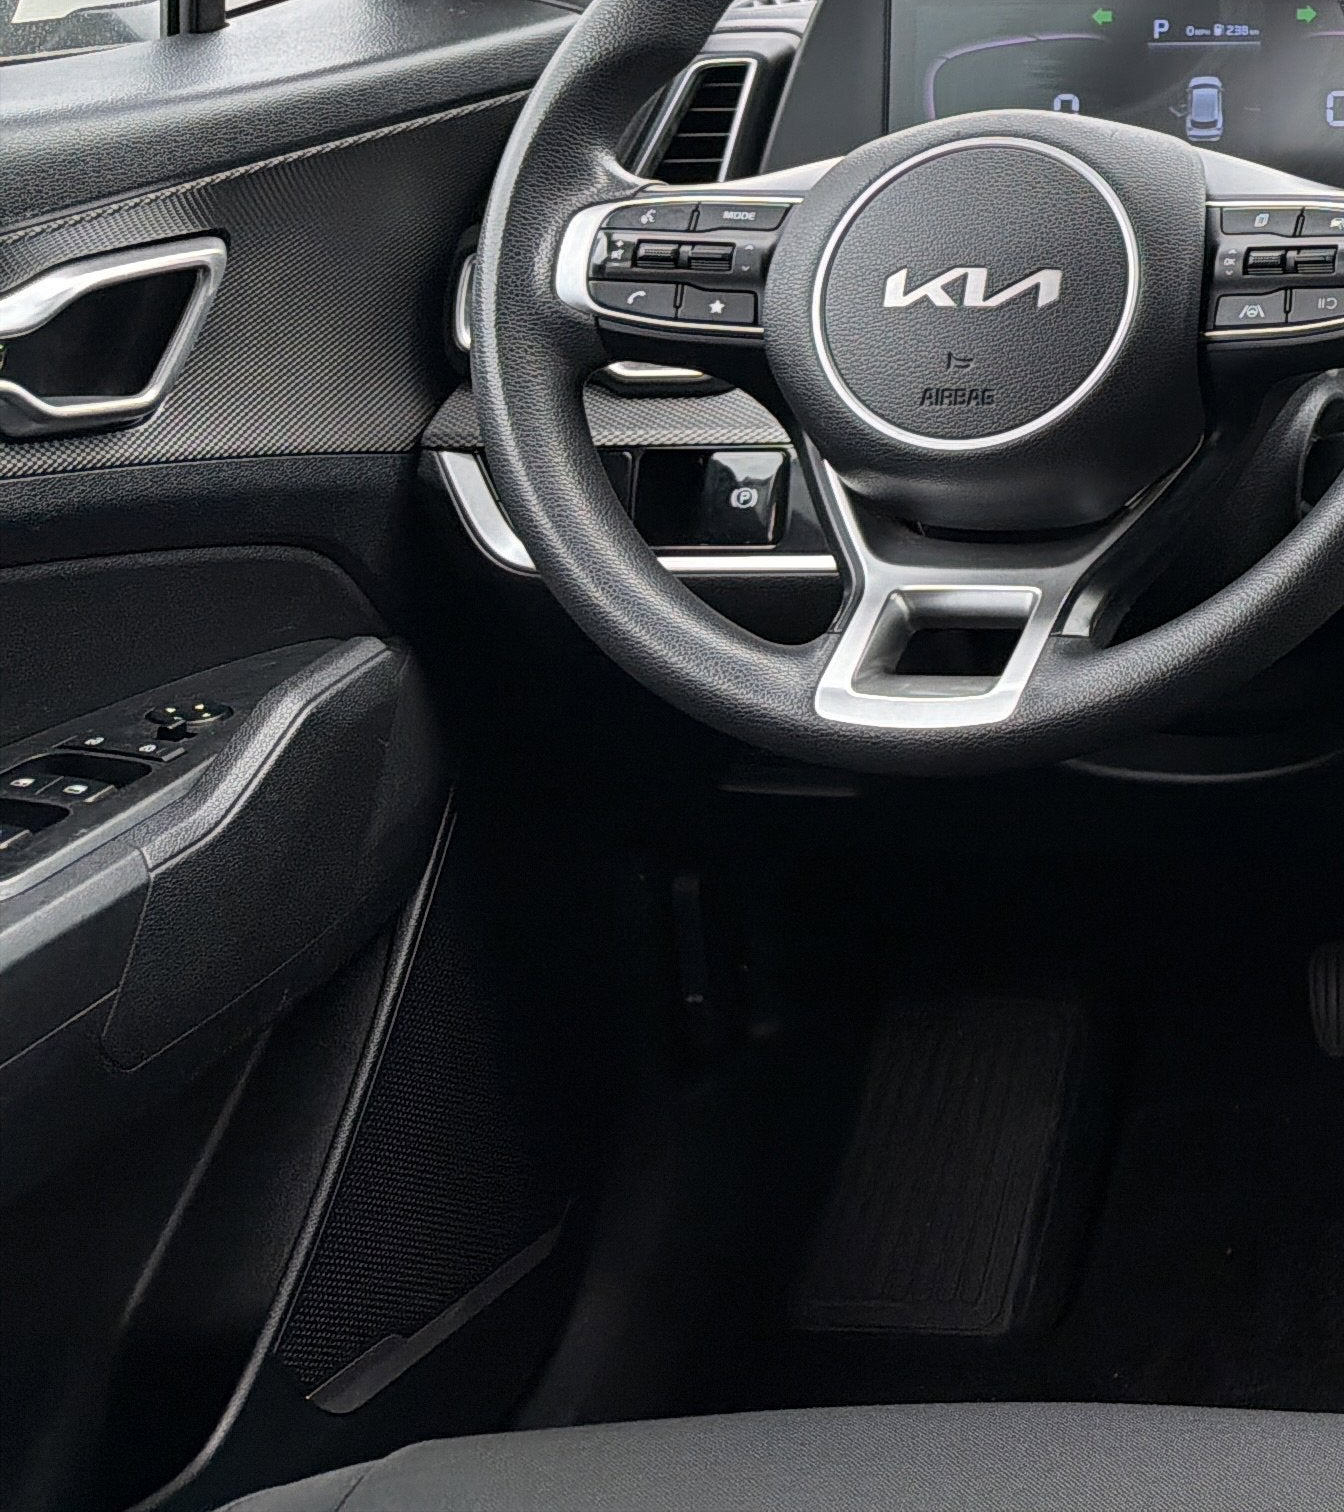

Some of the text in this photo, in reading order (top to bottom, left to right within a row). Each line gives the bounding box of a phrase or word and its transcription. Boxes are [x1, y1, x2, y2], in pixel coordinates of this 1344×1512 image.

[1153, 19, 1170, 39] P
[723, 210, 756, 221] MODE
[883, 266, 1063, 308] KIA
[920, 387, 995, 406] AIRBAG
